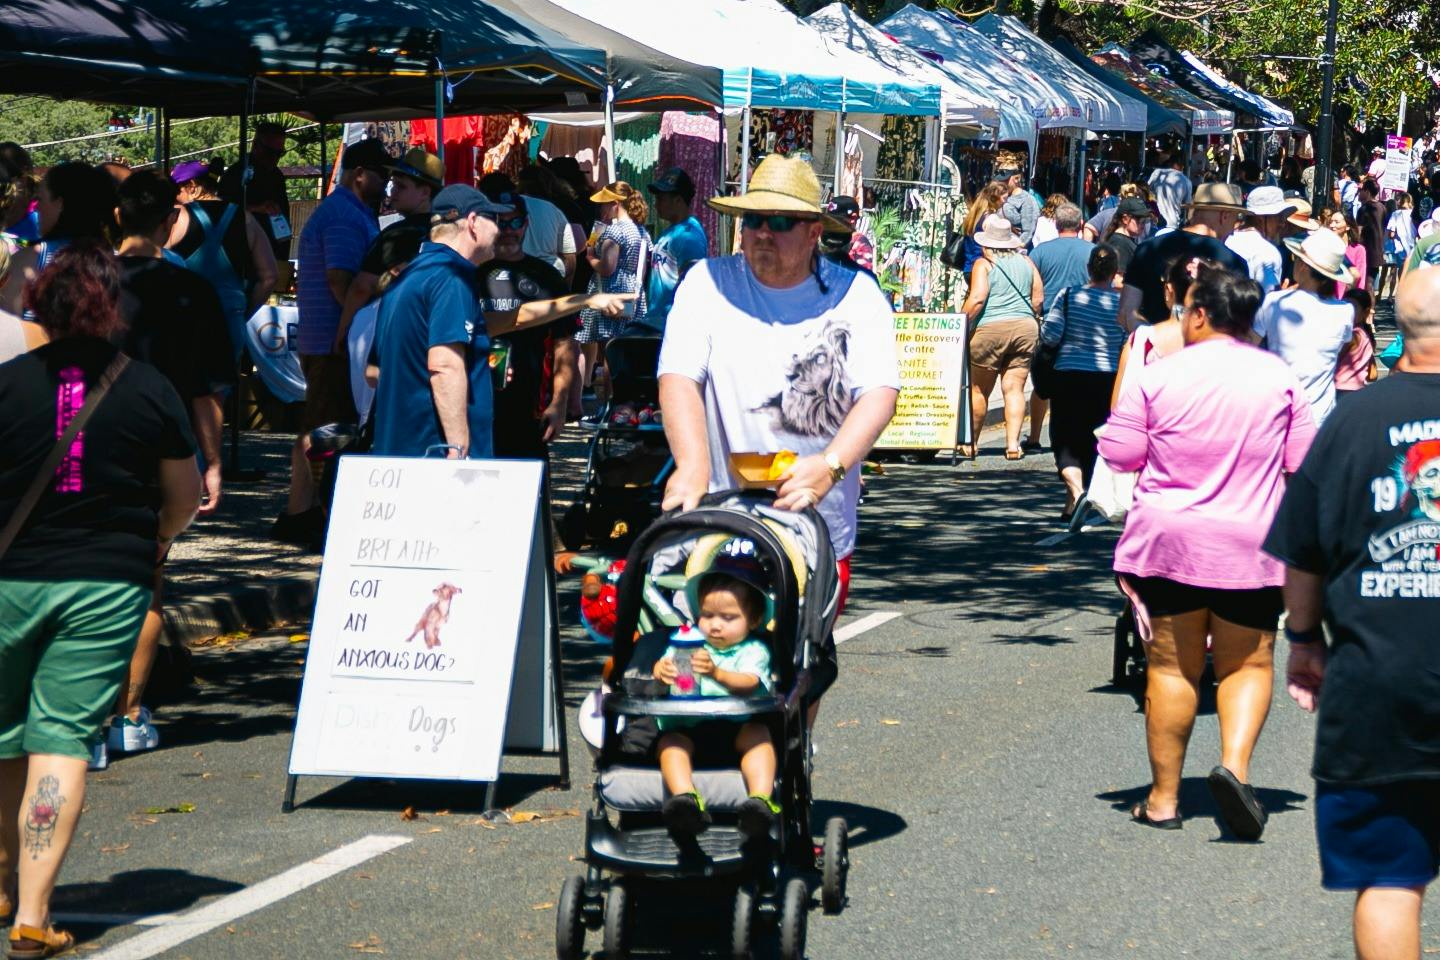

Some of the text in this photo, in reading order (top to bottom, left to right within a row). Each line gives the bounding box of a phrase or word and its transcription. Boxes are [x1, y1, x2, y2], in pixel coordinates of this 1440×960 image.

[912, 317, 962, 330] TASTINGS
[904, 345, 935, 354] Centre
[914, 334, 961, 345] Discovery
[367, 467, 405, 489] GOT
[1370, 476, 1398, 513] 19
[362, 501, 397, 521] BAD
[1410, 547, 1436, 560] AM
[349, 578, 383, 599] GOT
[343, 613, 368, 632] AN
[337, 648, 456, 672] ANXIOUS DOG?
[407, 705, 458, 746] Dogs
